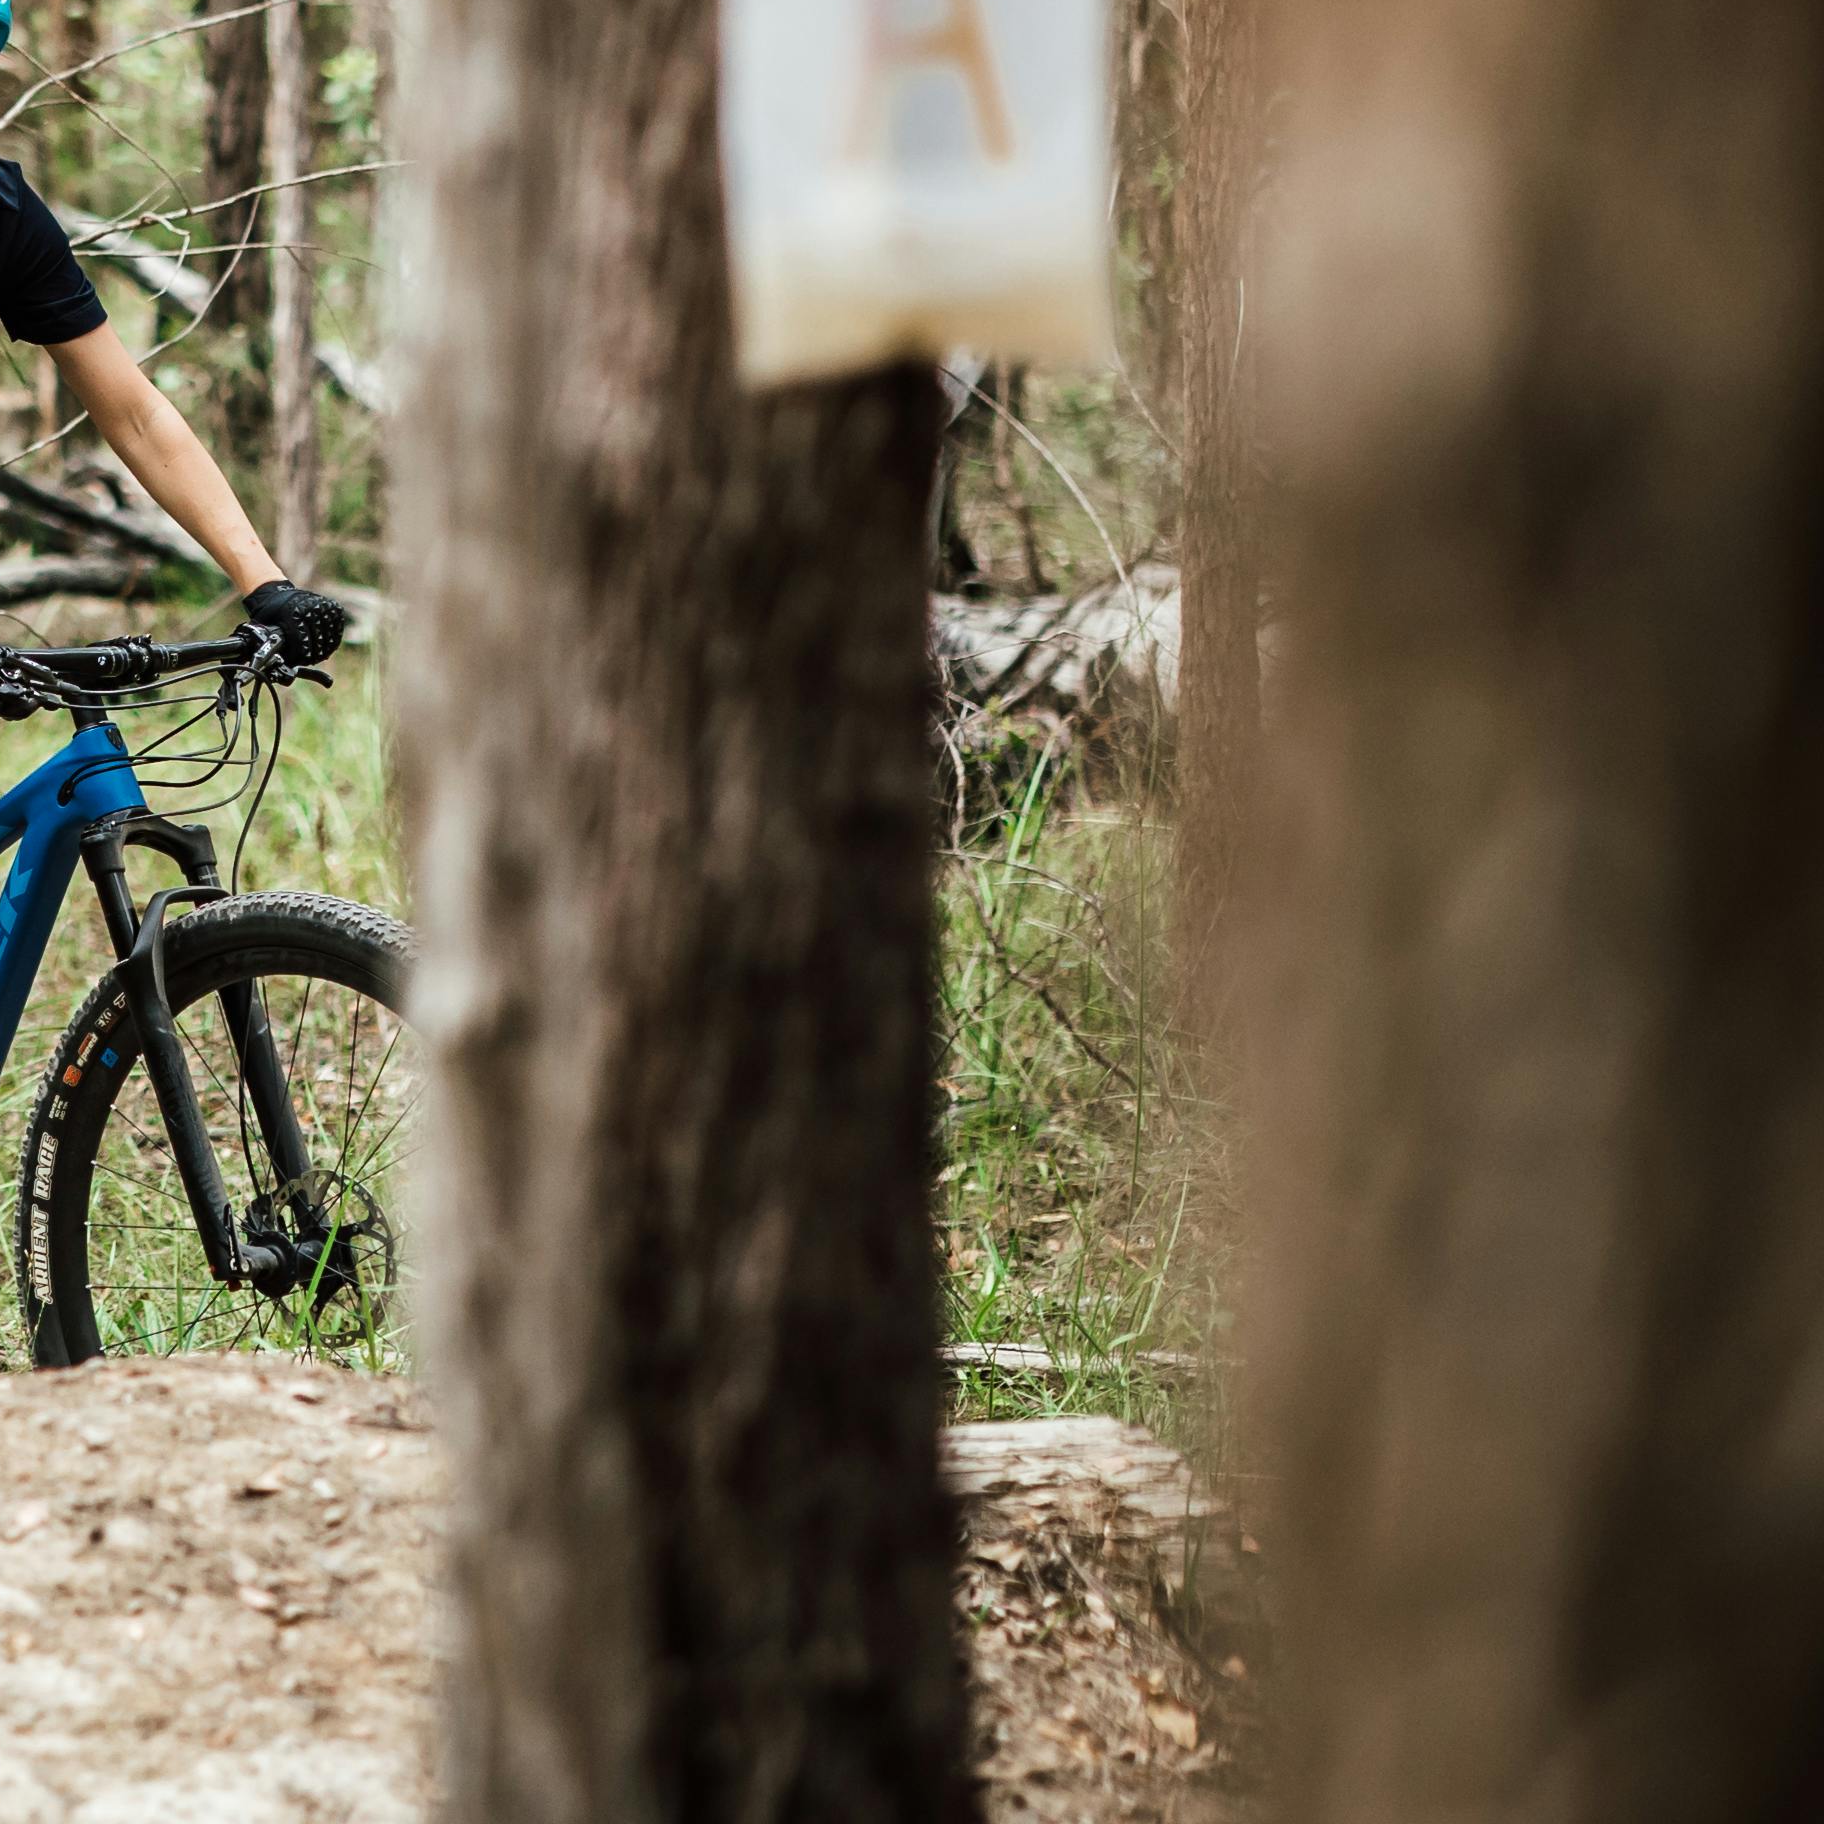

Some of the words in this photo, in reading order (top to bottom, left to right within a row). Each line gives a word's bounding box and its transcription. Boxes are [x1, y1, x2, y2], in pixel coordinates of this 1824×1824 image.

[96, 1008, 114, 1029] EXO
[33, 1132, 58, 1200] RACE
[31, 1204, 53, 1305] ARDENT
